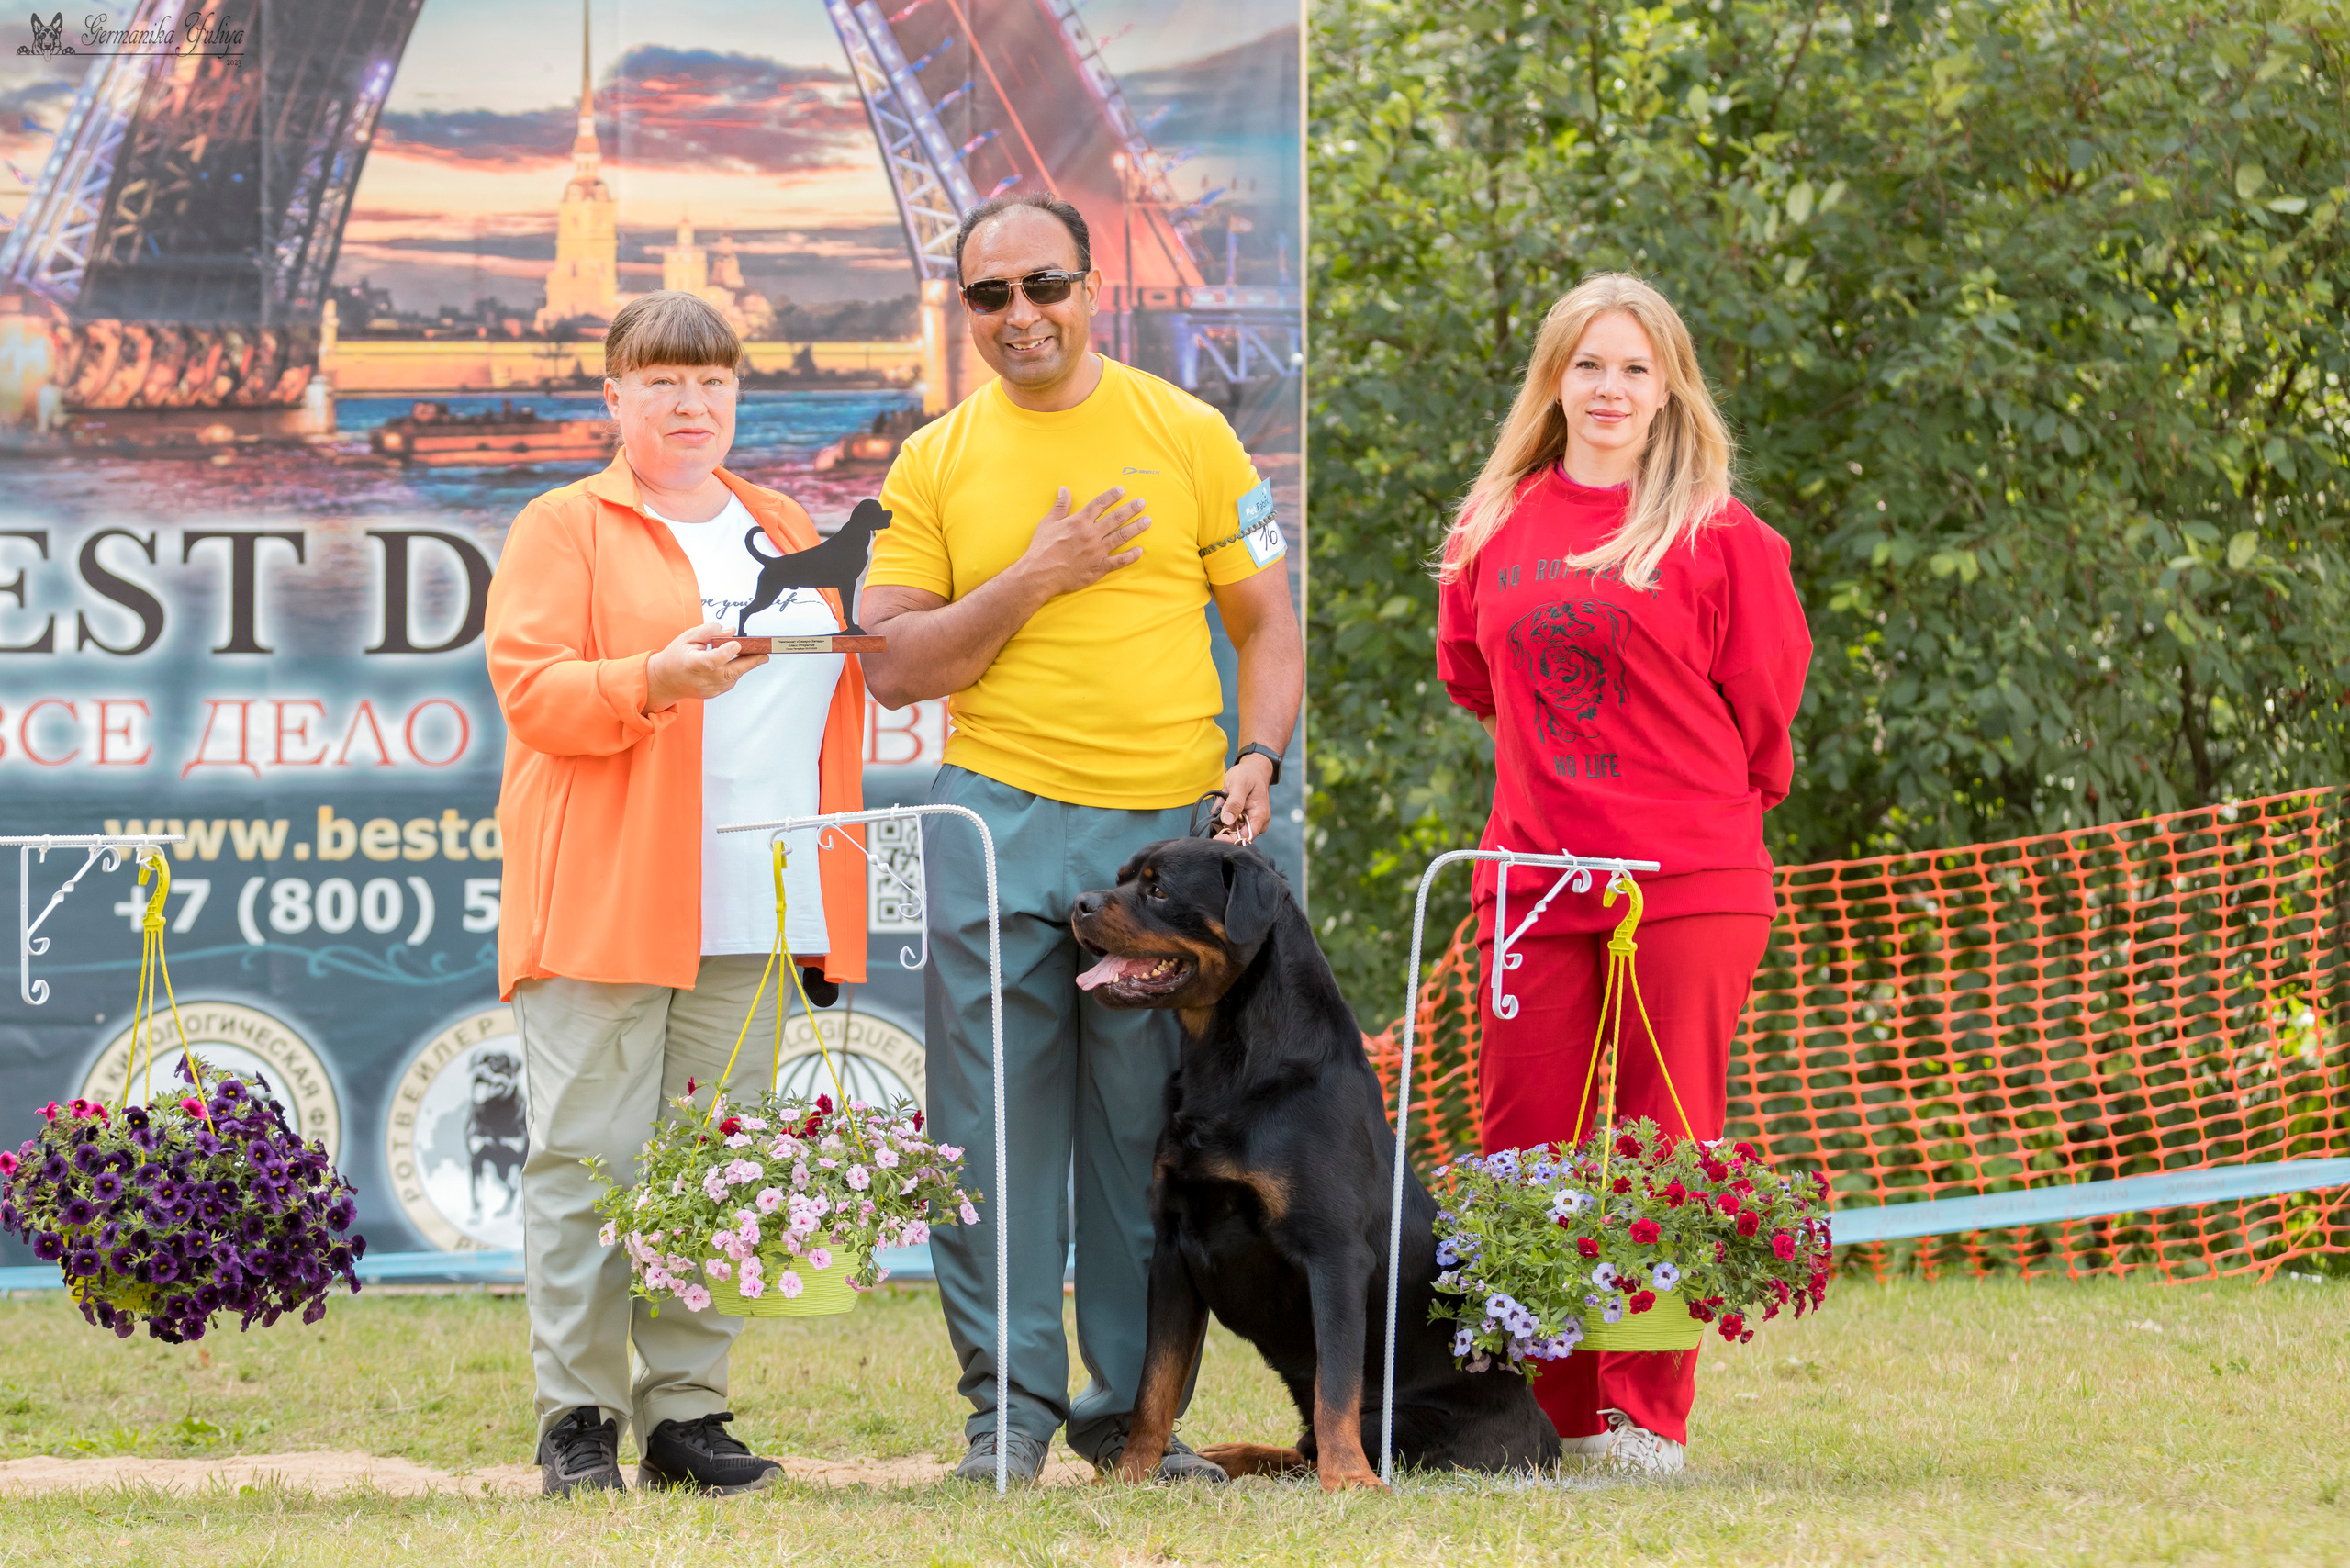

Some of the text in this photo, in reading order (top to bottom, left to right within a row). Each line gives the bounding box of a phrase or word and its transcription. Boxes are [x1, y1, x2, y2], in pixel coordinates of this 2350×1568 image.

[1498, 564, 1521, 592] NO
[0, 698, 153, 767] СЕ
[181, 698, 471, 779] ДЕЛО
[1553, 753, 1621, 778] NO LIFE
[237, 877, 436, 946] (800)
